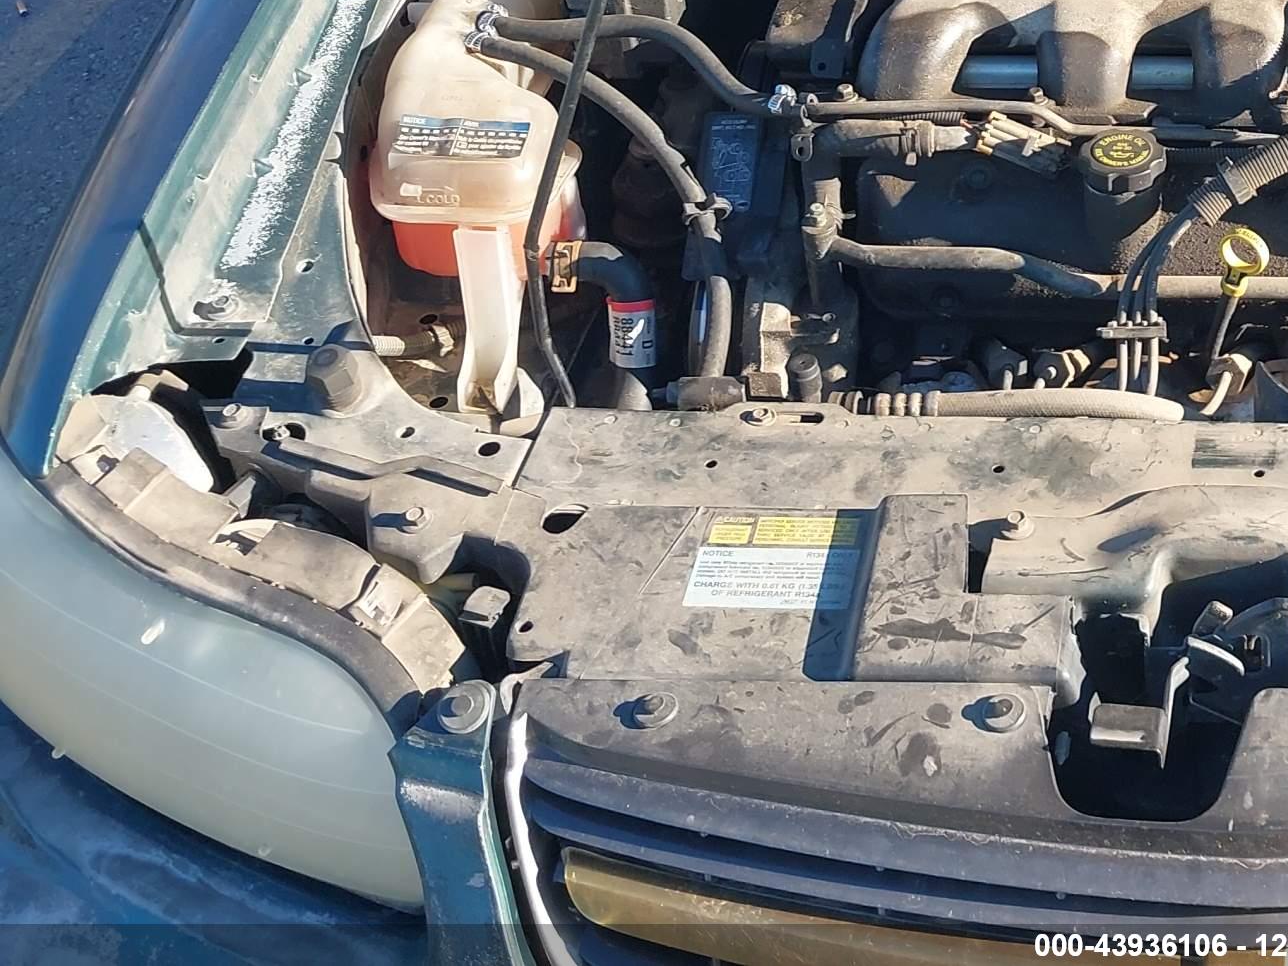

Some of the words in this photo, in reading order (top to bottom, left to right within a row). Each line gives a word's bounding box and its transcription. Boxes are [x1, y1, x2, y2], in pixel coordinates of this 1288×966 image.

[735, 581, 760, 589] WITH
[781, 582, 796, 590] KG
[711, 589, 724, 597] OF
[725, 589, 793, 598] REFRIGERANT
